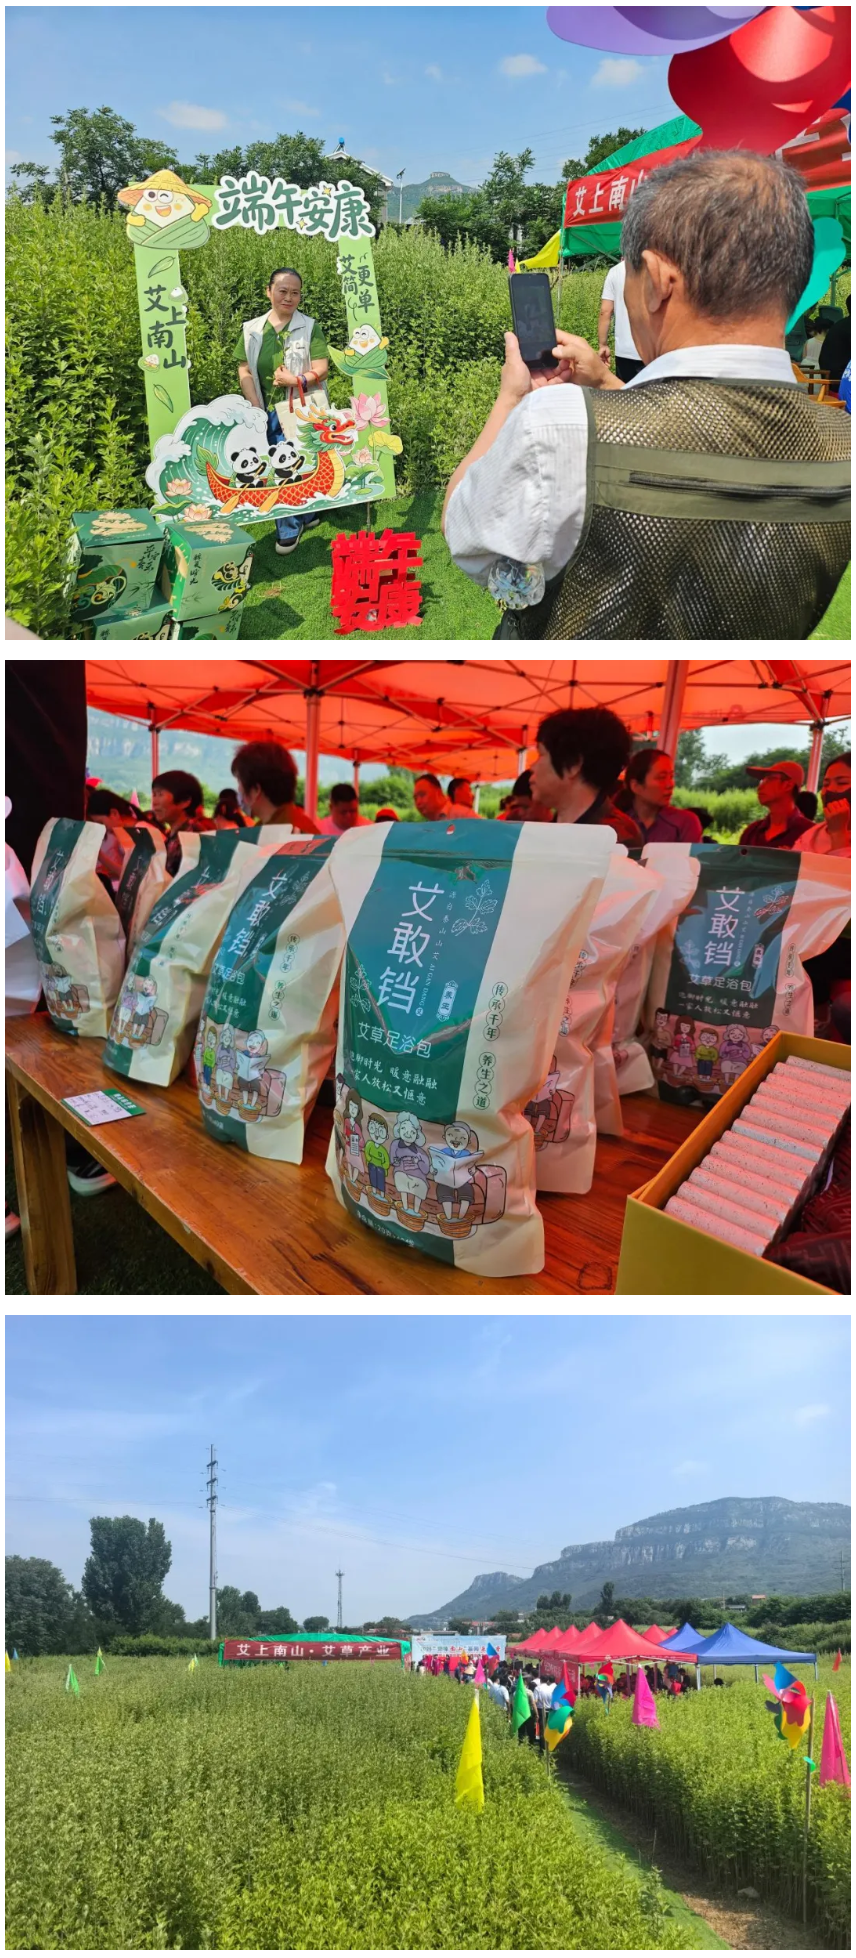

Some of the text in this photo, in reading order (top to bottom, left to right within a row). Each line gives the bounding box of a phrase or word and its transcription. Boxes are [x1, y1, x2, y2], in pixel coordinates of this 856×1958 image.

[215, 174, 374, 237] 端午安康
[377, 881, 445, 1015] 艾敢铛
[704, 886, 746, 967] 艾敢铛
[687, 973, 752, 992] 艾草足浴包
[484, 983, 507, 1040] 传承千年
[357, 1021, 432, 1059] 艾草足浴包
[353, 1069, 427, 1106] 家人放松又惬意
[389, 1067, 438, 1090] 暖意融融
[474, 1053, 496, 1109] 养生之道
